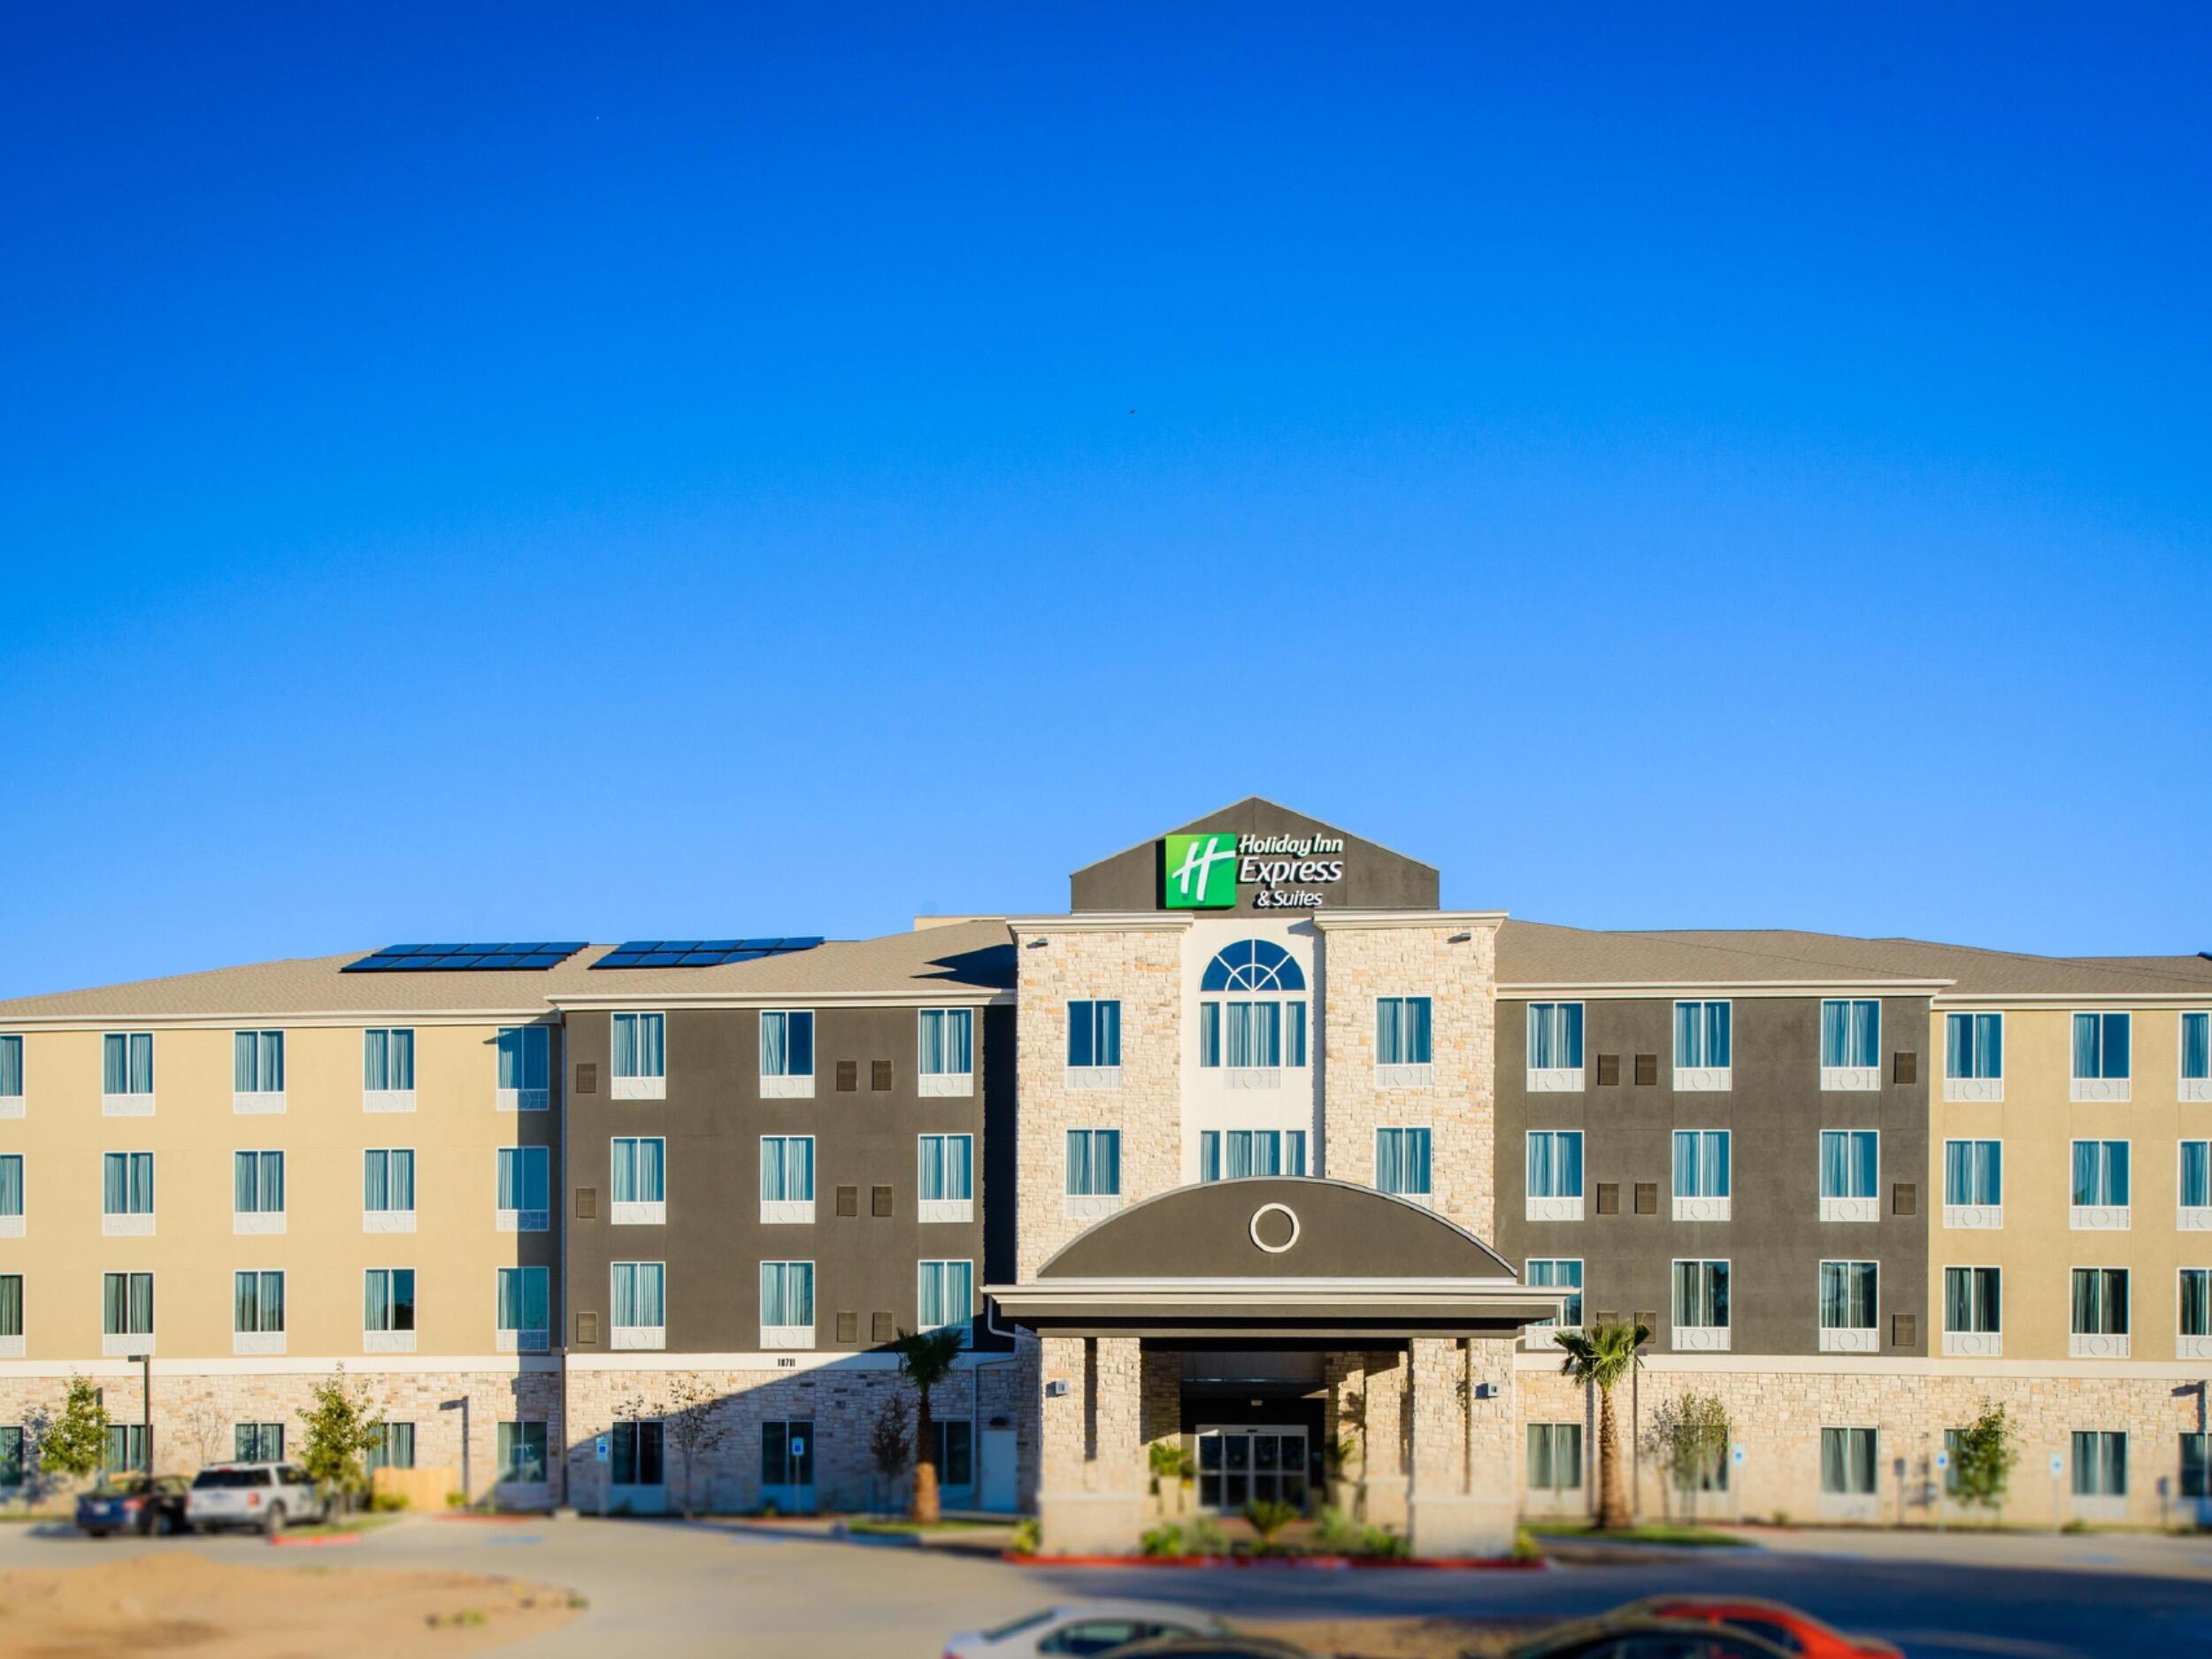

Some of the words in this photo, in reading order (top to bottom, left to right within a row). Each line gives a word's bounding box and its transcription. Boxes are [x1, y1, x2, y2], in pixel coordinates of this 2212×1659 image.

[1239, 833, 1311, 856] Holiday
[1315, 833, 1344, 853] Inn
[1171, 837, 1236, 902] H
[1240, 856, 1343, 888] Express
[1257, 893, 1271, 907] &
[1272, 890, 1324, 907] Suites
